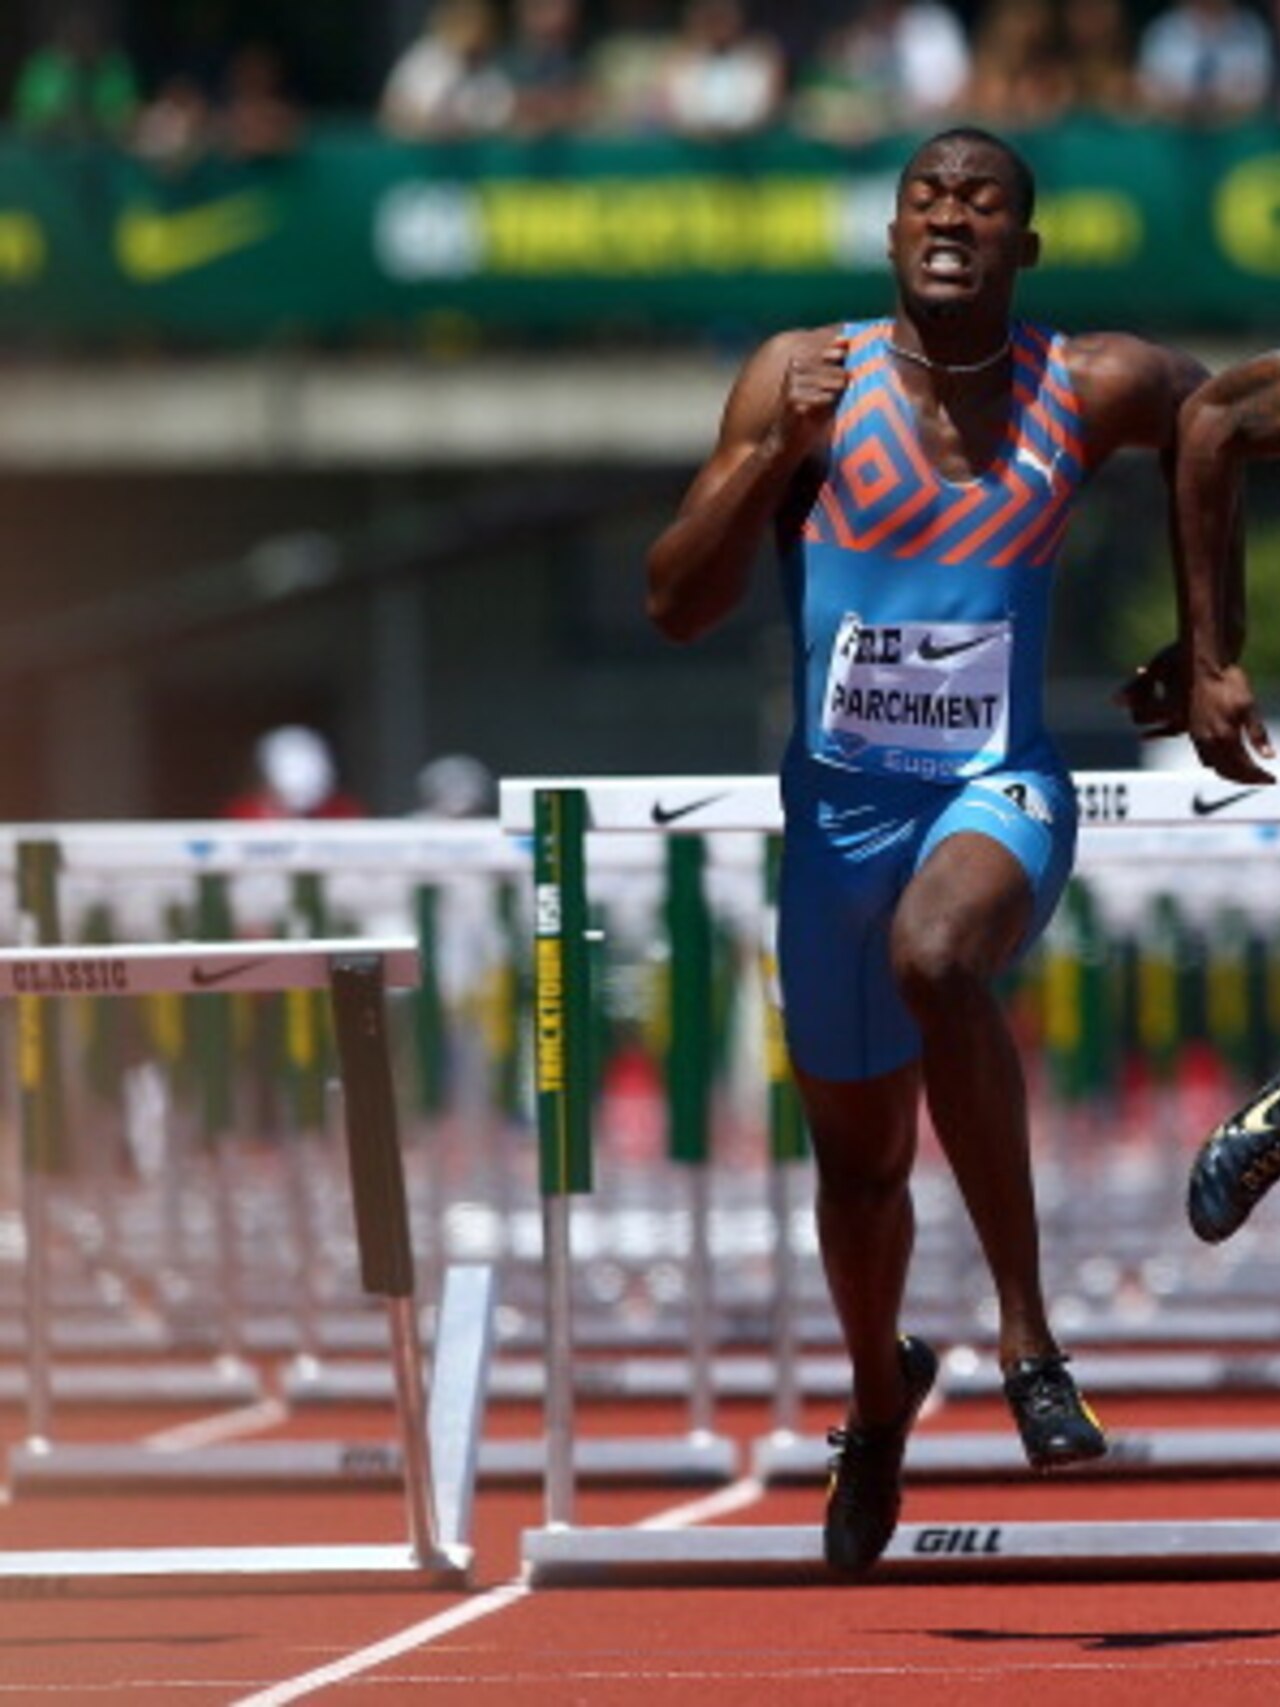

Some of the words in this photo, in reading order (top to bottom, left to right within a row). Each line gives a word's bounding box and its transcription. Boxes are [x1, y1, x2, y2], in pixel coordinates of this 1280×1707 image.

[830, 684, 998, 730] PARCHMENT
[537, 883, 563, 934] USA
[11, 961, 127, 991] CLASSIC
[537, 938, 564, 1091] TRACKTOWN
[912, 1528, 1002, 1552] GILL
